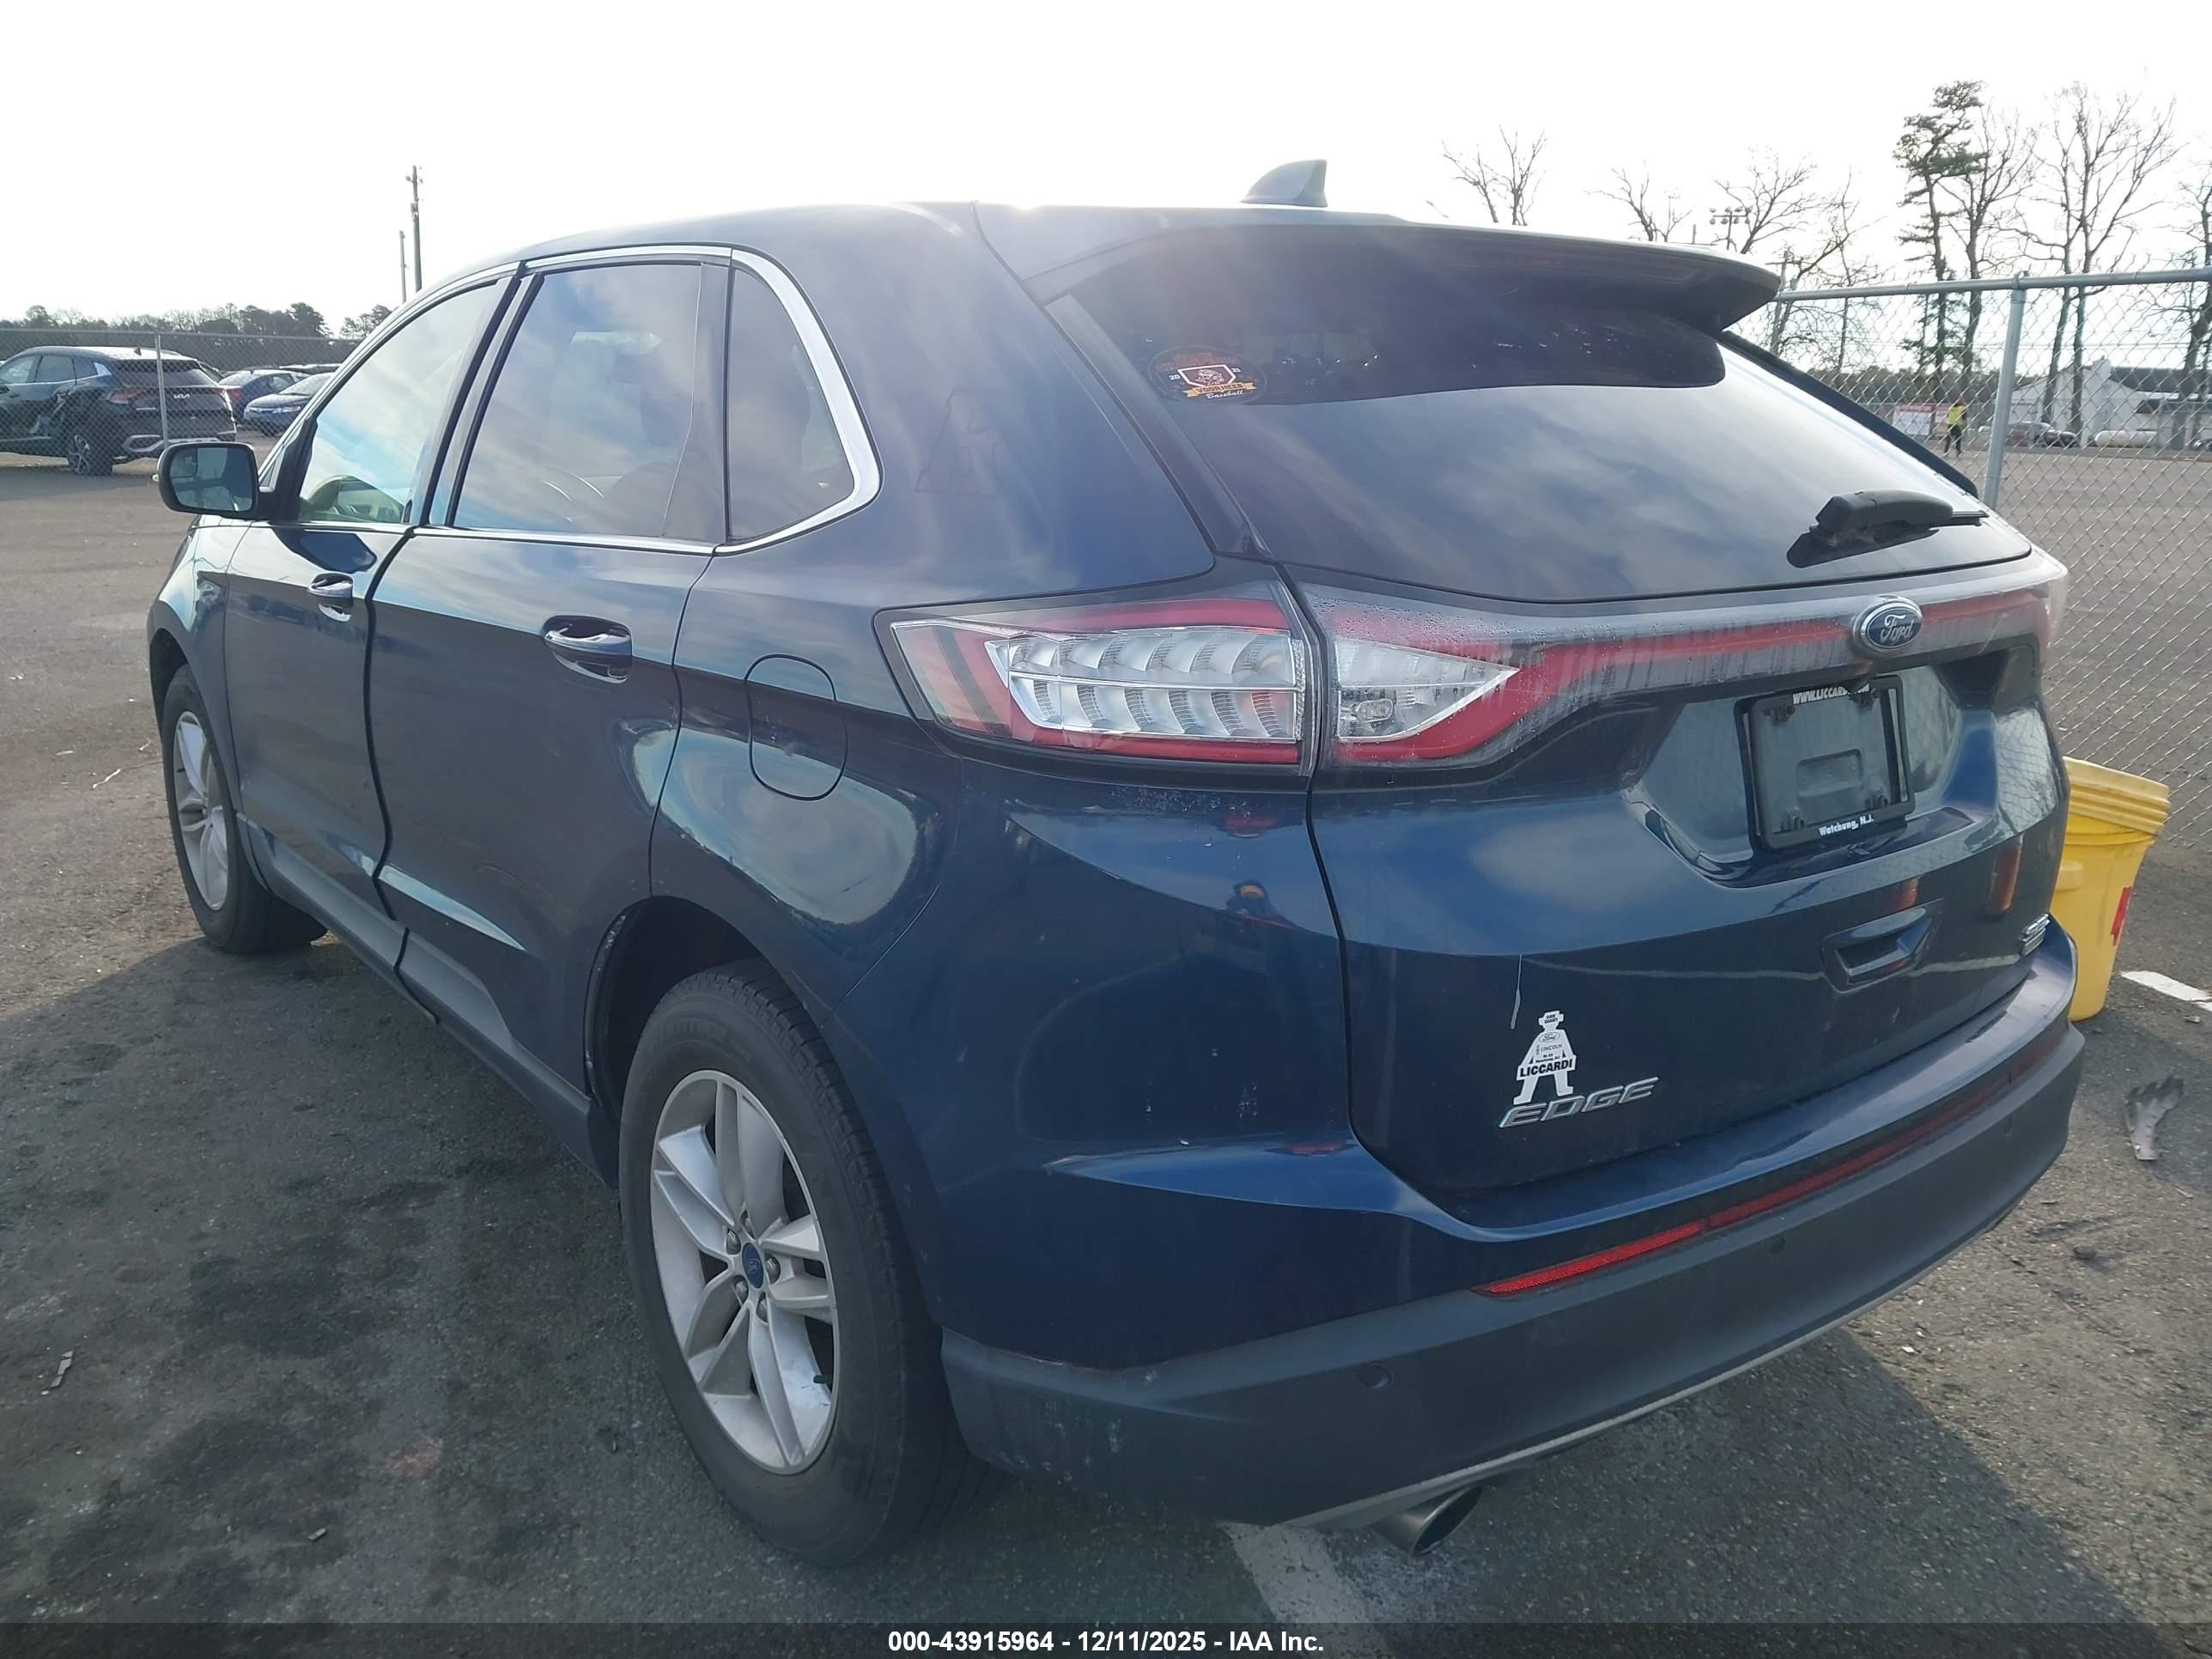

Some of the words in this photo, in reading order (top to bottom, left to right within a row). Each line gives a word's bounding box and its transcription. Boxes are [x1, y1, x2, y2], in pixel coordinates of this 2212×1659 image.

[1195, 384, 1244, 393] VOORHEES
[1206, 389, 1244, 399] Baseball
[1881, 614, 1914, 642] Ford
[1819, 820, 1859, 836] Watchung,
[1859, 813, 1875, 825] N.J.
[1541, 1043, 1563, 1052] LINCOLN
[1520, 1058, 1573, 1078] LICCARDI
[1498, 1076, 1659, 1128] EDGE
